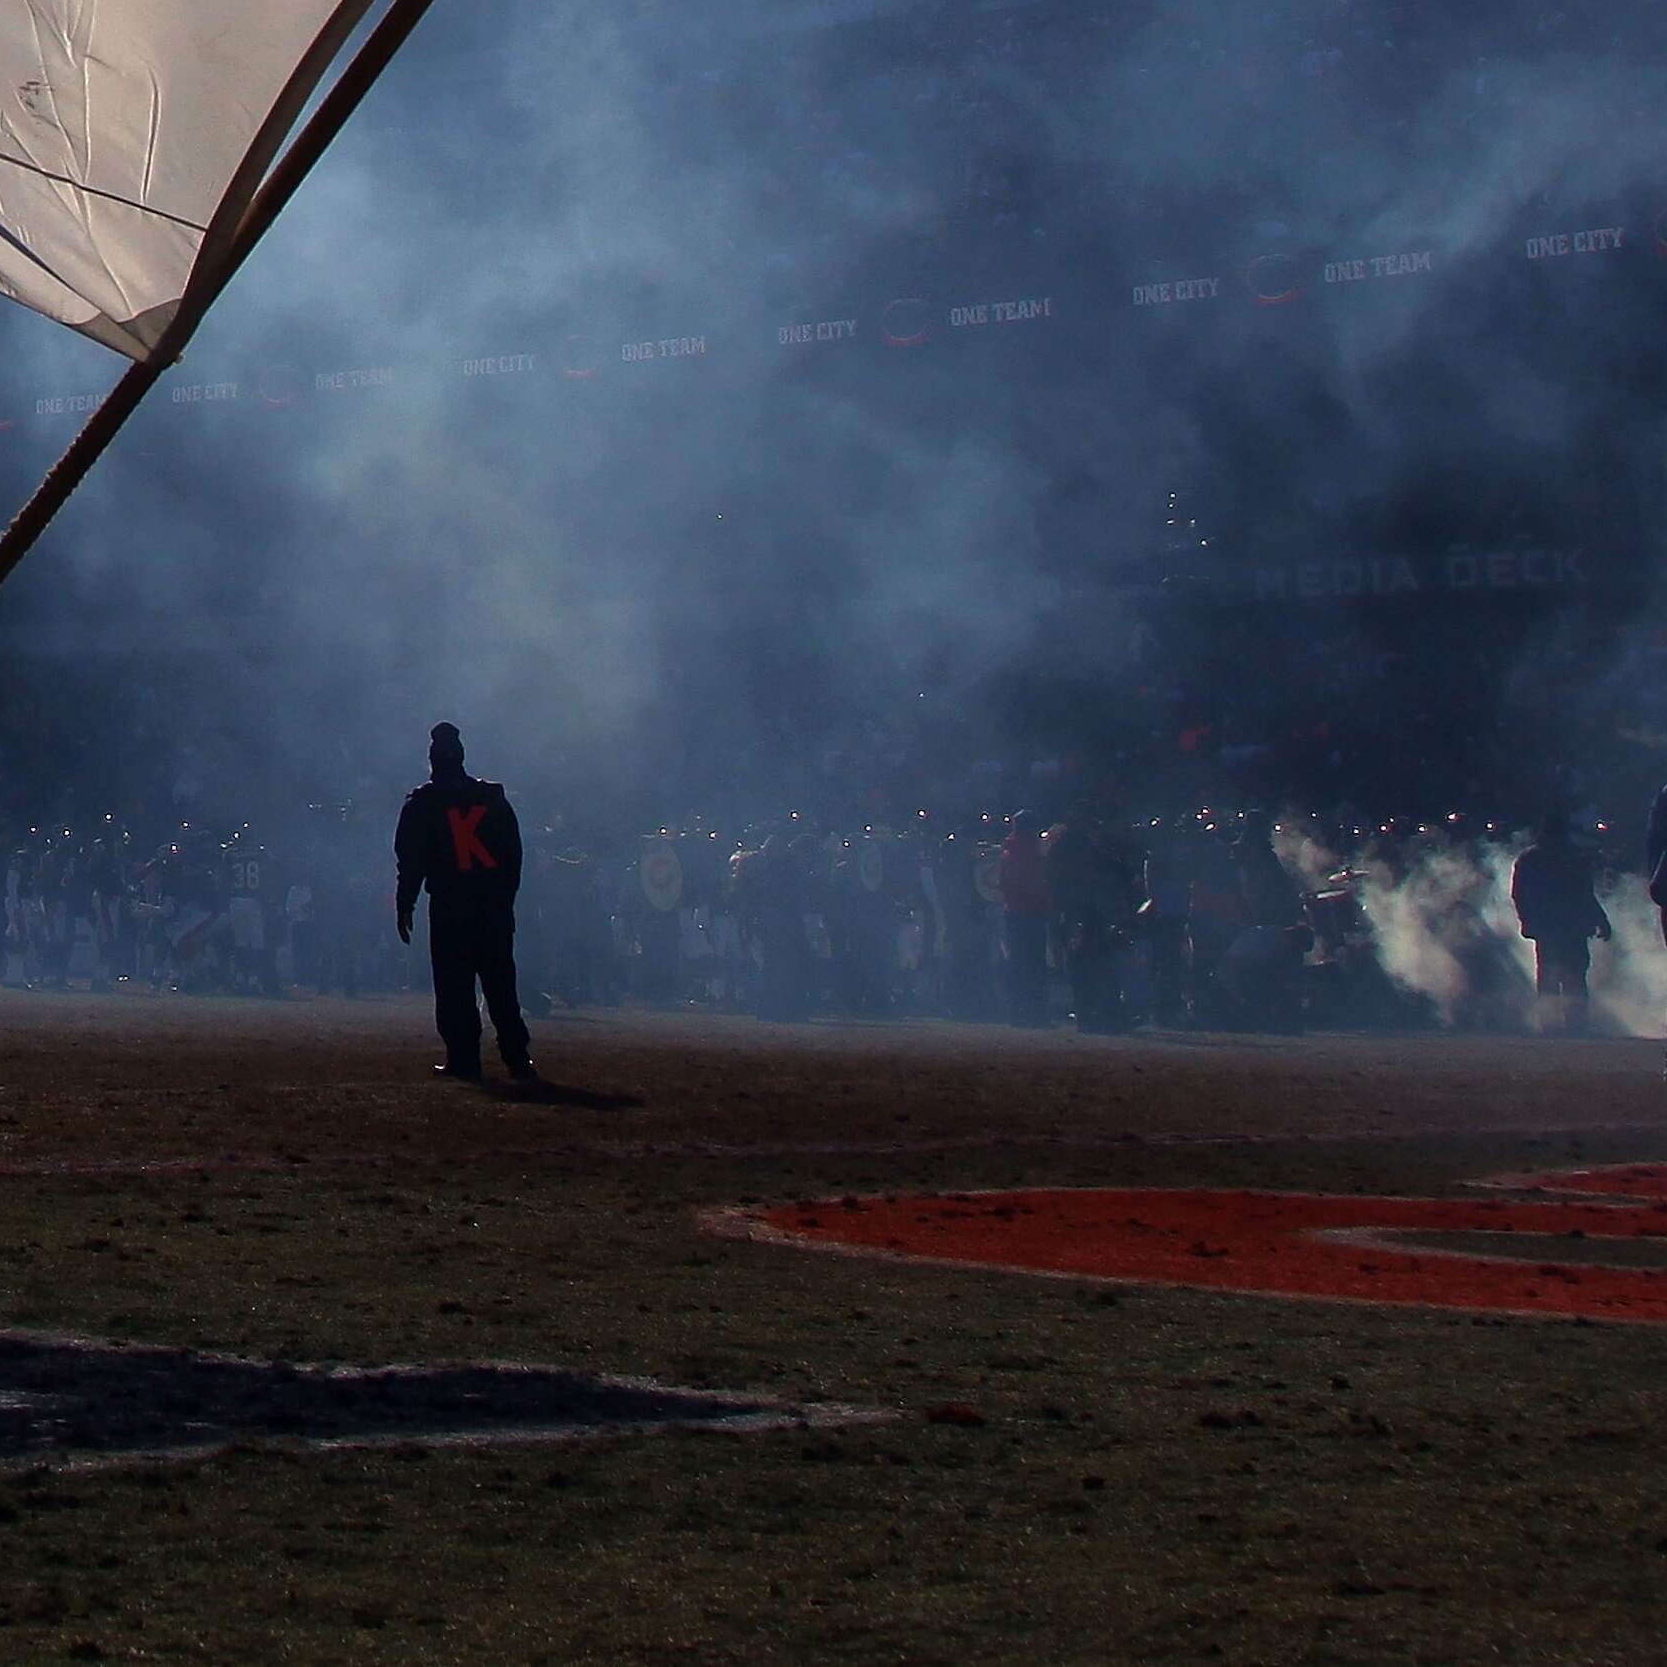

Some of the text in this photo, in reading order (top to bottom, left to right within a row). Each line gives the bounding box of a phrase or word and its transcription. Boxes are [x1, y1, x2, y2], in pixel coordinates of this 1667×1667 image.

[1527, 227, 1624, 259] ONE CITY
[1133, 282, 1170, 305] ONE
[1175, 277, 1220, 300] CITY
[1325, 259, 1365, 283] ONE
[1370, 251, 1433, 278] TEAM
[779, 323, 812, 345] ONE
[817, 318, 856, 340] CITY
[951, 305, 987, 327] ONE
[992, 298, 1051, 323] TEAM
[464, 358, 494, 376] ONE
[498, 353, 534, 373] CITY
[622, 342, 654, 362] ONE
[659, 336, 706, 357] TEAM
[36, 398, 63, 414] ONE
[173, 386, 201, 403] ONE
[1253, 547, 1594, 599] MEDIA DECK
[447, 805, 499, 871] K
